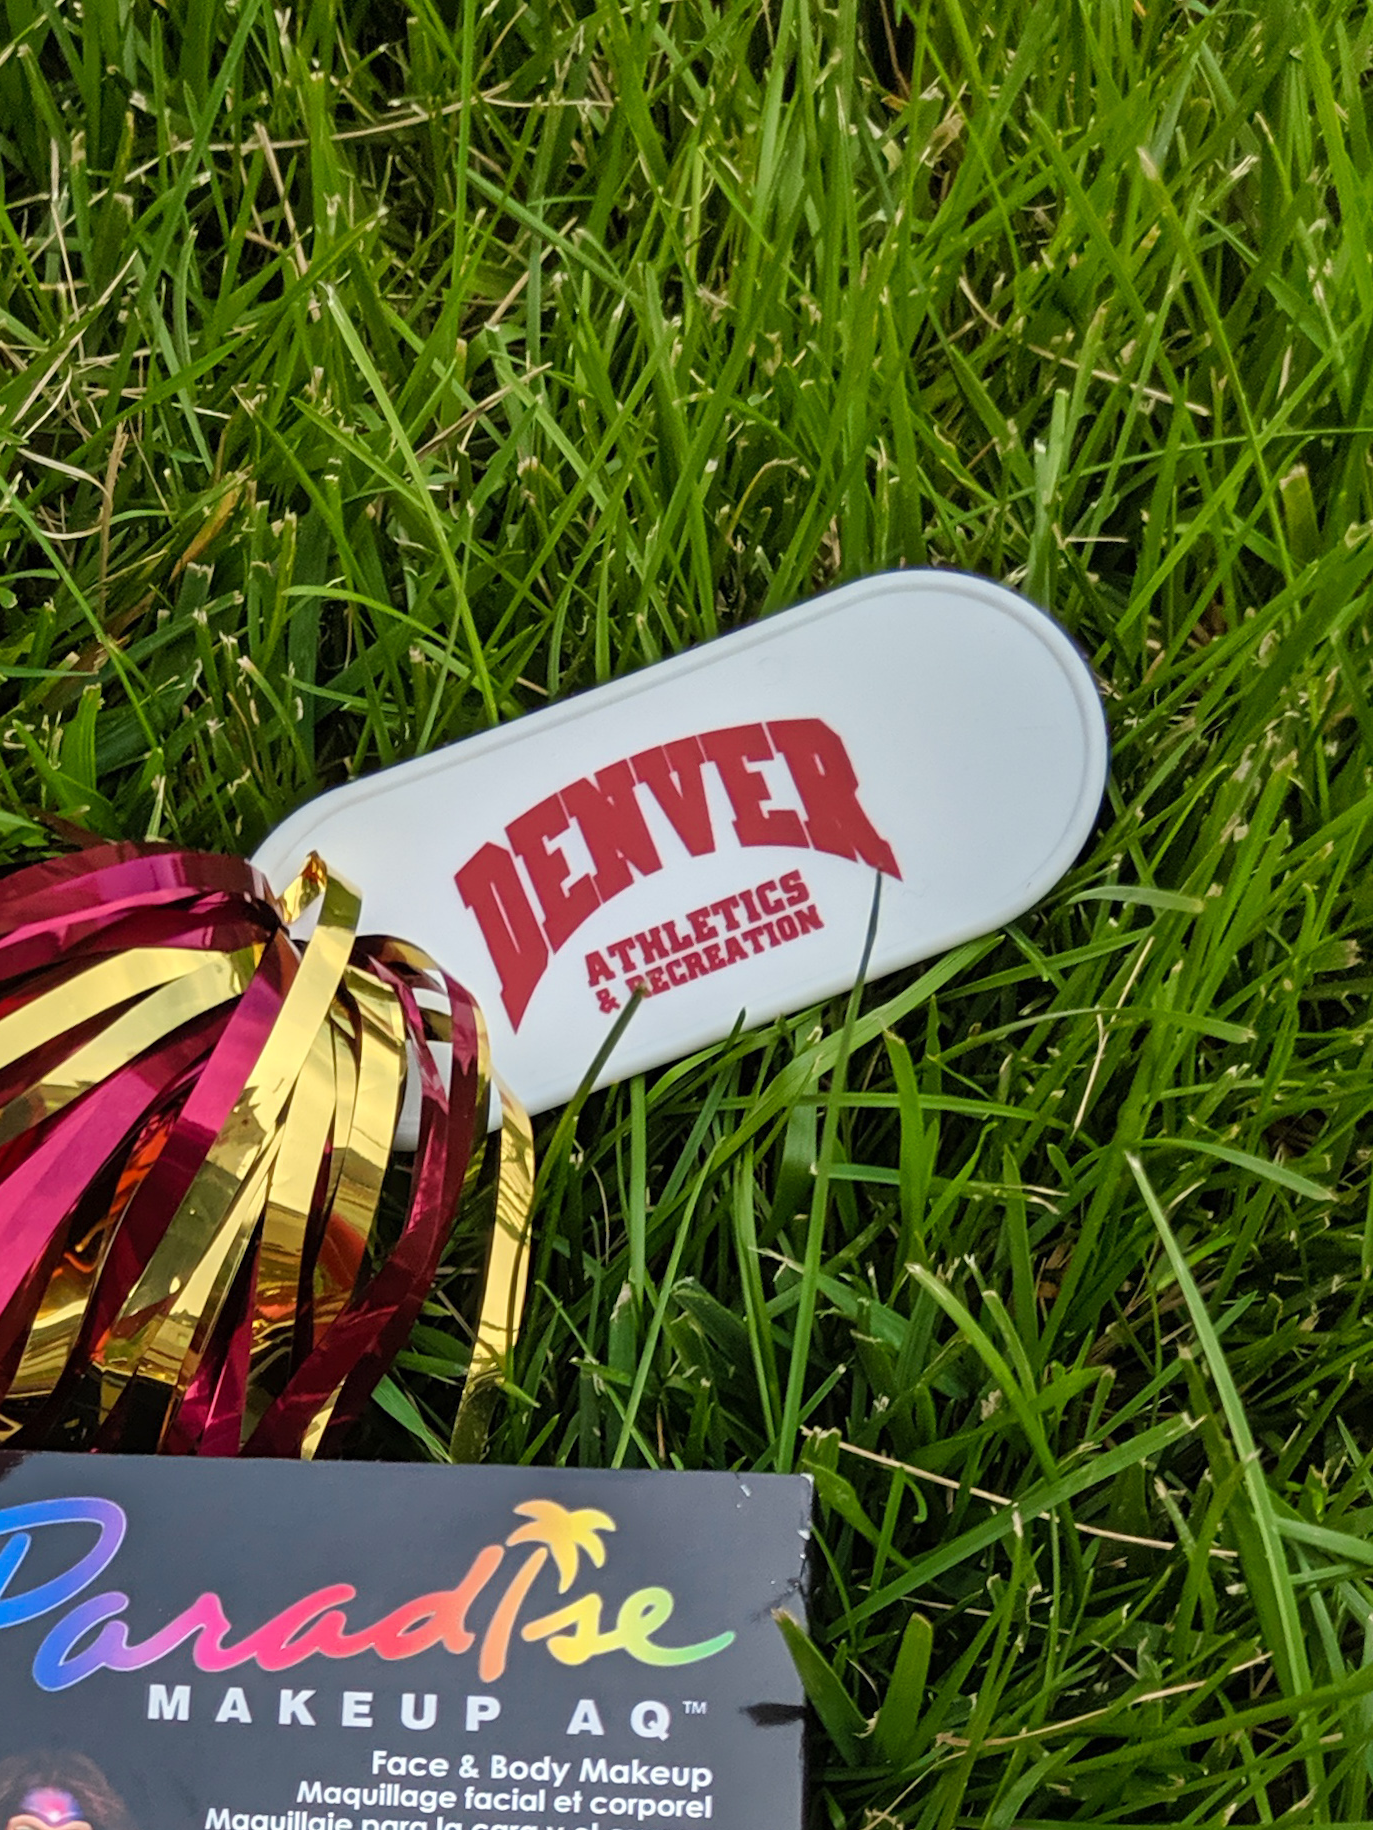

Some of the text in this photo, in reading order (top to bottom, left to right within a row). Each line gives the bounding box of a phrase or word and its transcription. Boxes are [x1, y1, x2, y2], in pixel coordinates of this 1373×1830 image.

[454, 717, 903, 1034] DENVER
[585, 869, 809, 987] ATHLETICS
[595, 904, 824, 1014] & RECREATION
[147, 1683, 501, 1733] MAKEUP
[296, 1781, 712, 1825] Maquillage facial et corporel
[371, 1750, 713, 1793] Face & Body Makeup
